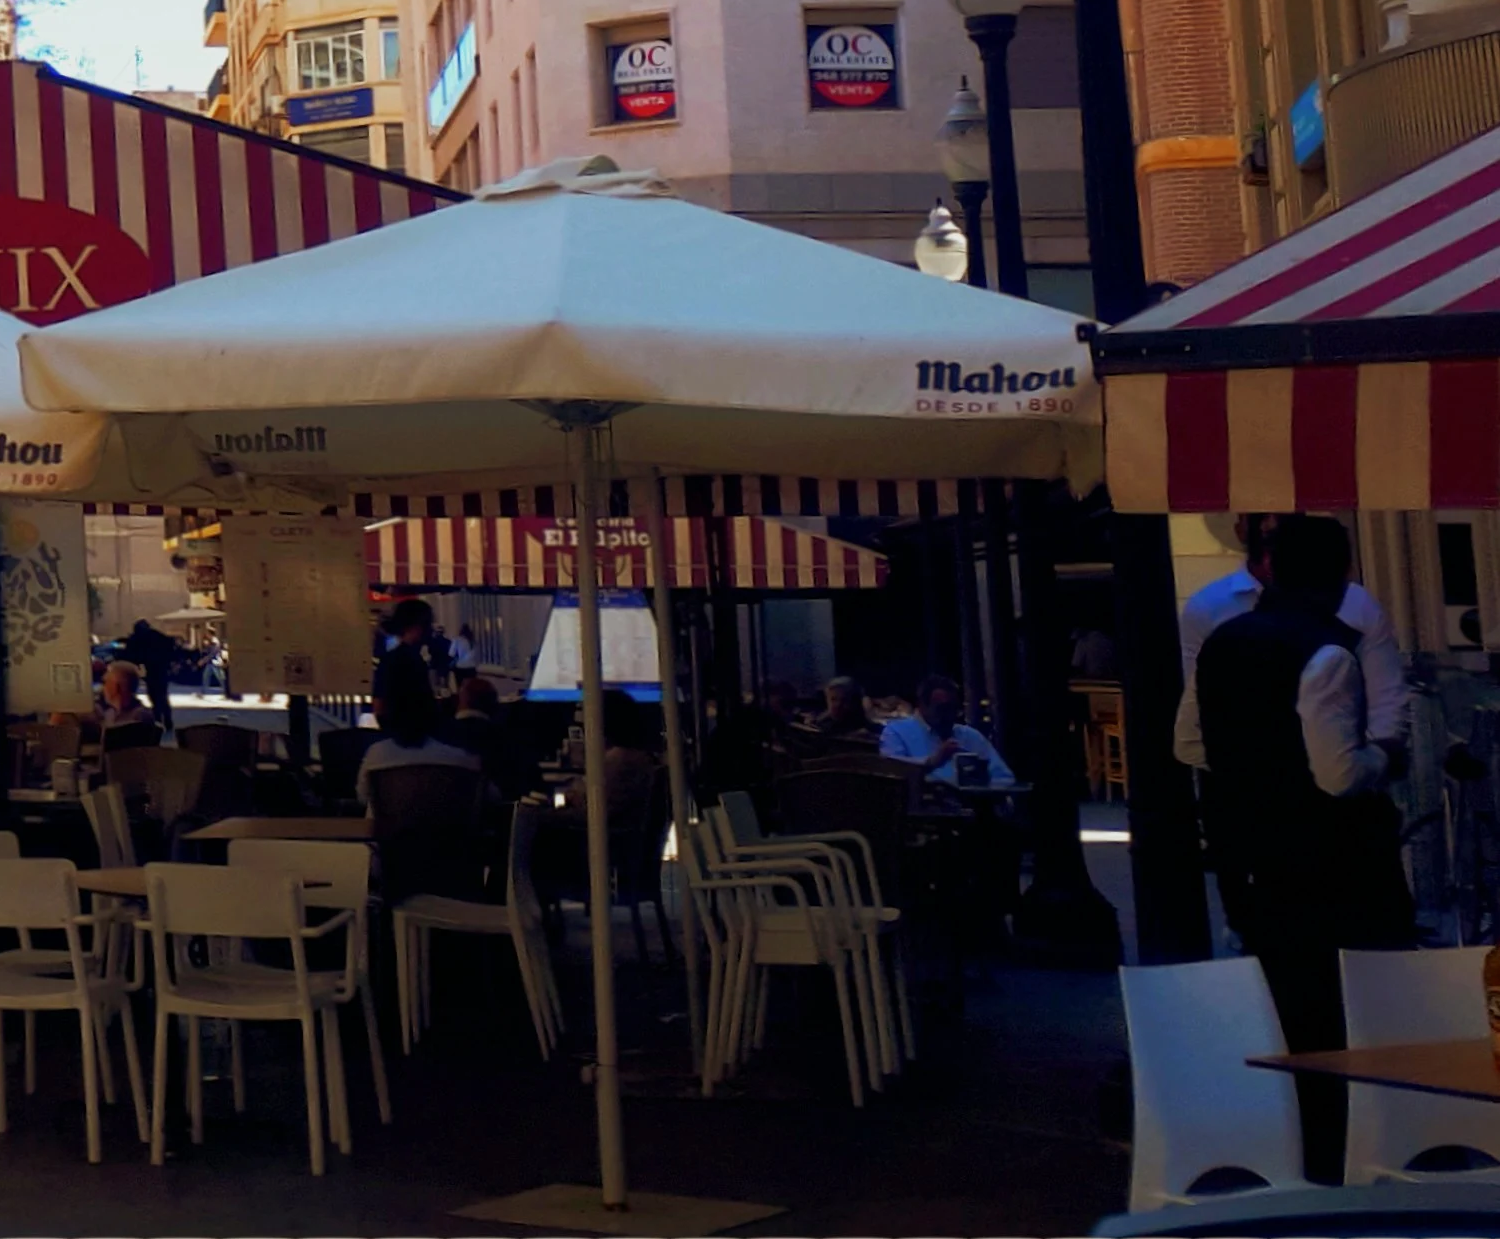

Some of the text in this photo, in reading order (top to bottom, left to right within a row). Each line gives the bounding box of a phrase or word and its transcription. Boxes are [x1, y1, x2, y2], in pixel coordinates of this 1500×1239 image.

[827, 33, 873, 56] OC
[628, 45, 667, 69] OC
[813, 55, 888, 64] REAL ESTATE
[617, 66, 672, 78] REAL ESTAT
[830, 84, 875, 95] VENTA
[629, 96, 666, 107] VENTA
[915, 359, 1076, 394] Mahou
[915, 398, 1075, 413] DESDE 1890
[10, 472, 59, 486] 1890
[543, 528, 564, 547] El
